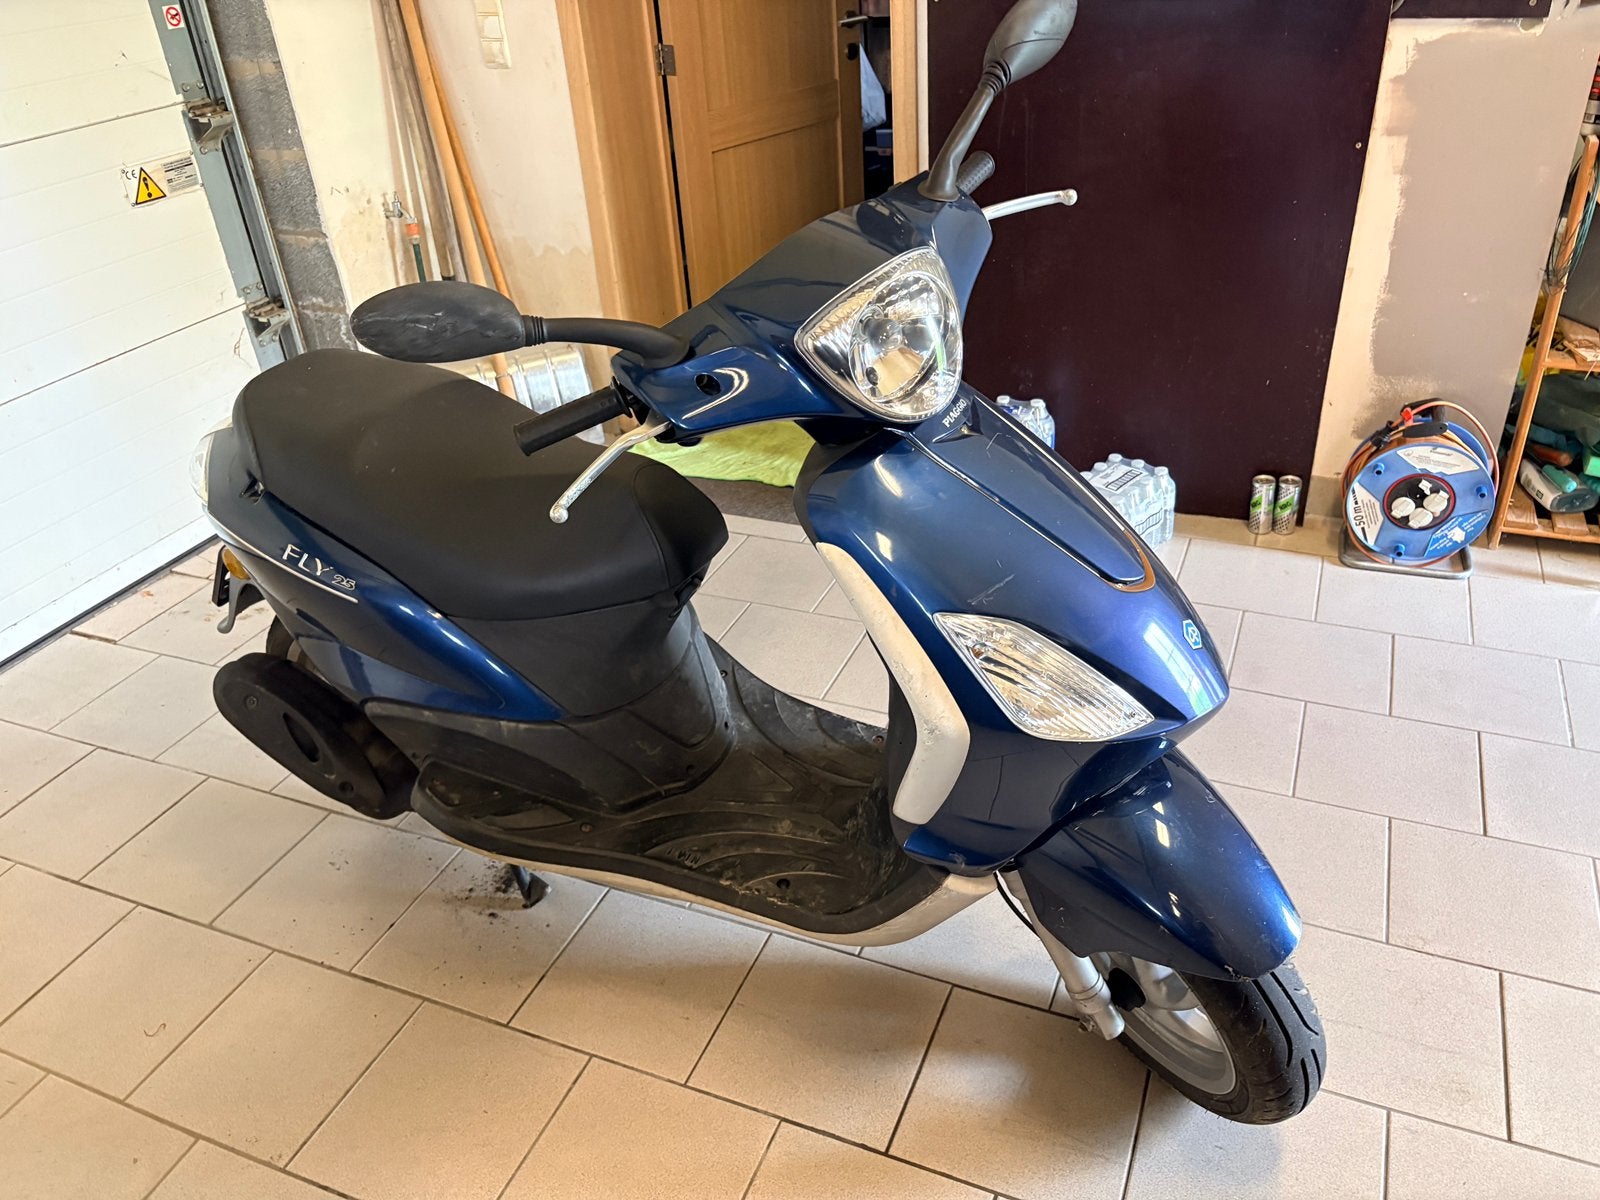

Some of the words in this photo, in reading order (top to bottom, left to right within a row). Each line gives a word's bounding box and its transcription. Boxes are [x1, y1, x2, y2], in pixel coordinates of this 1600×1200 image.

[942, 398, 967, 427] PIAGGIO
[1353, 515, 1366, 527] 50
[282, 543, 334, 576] FLY
